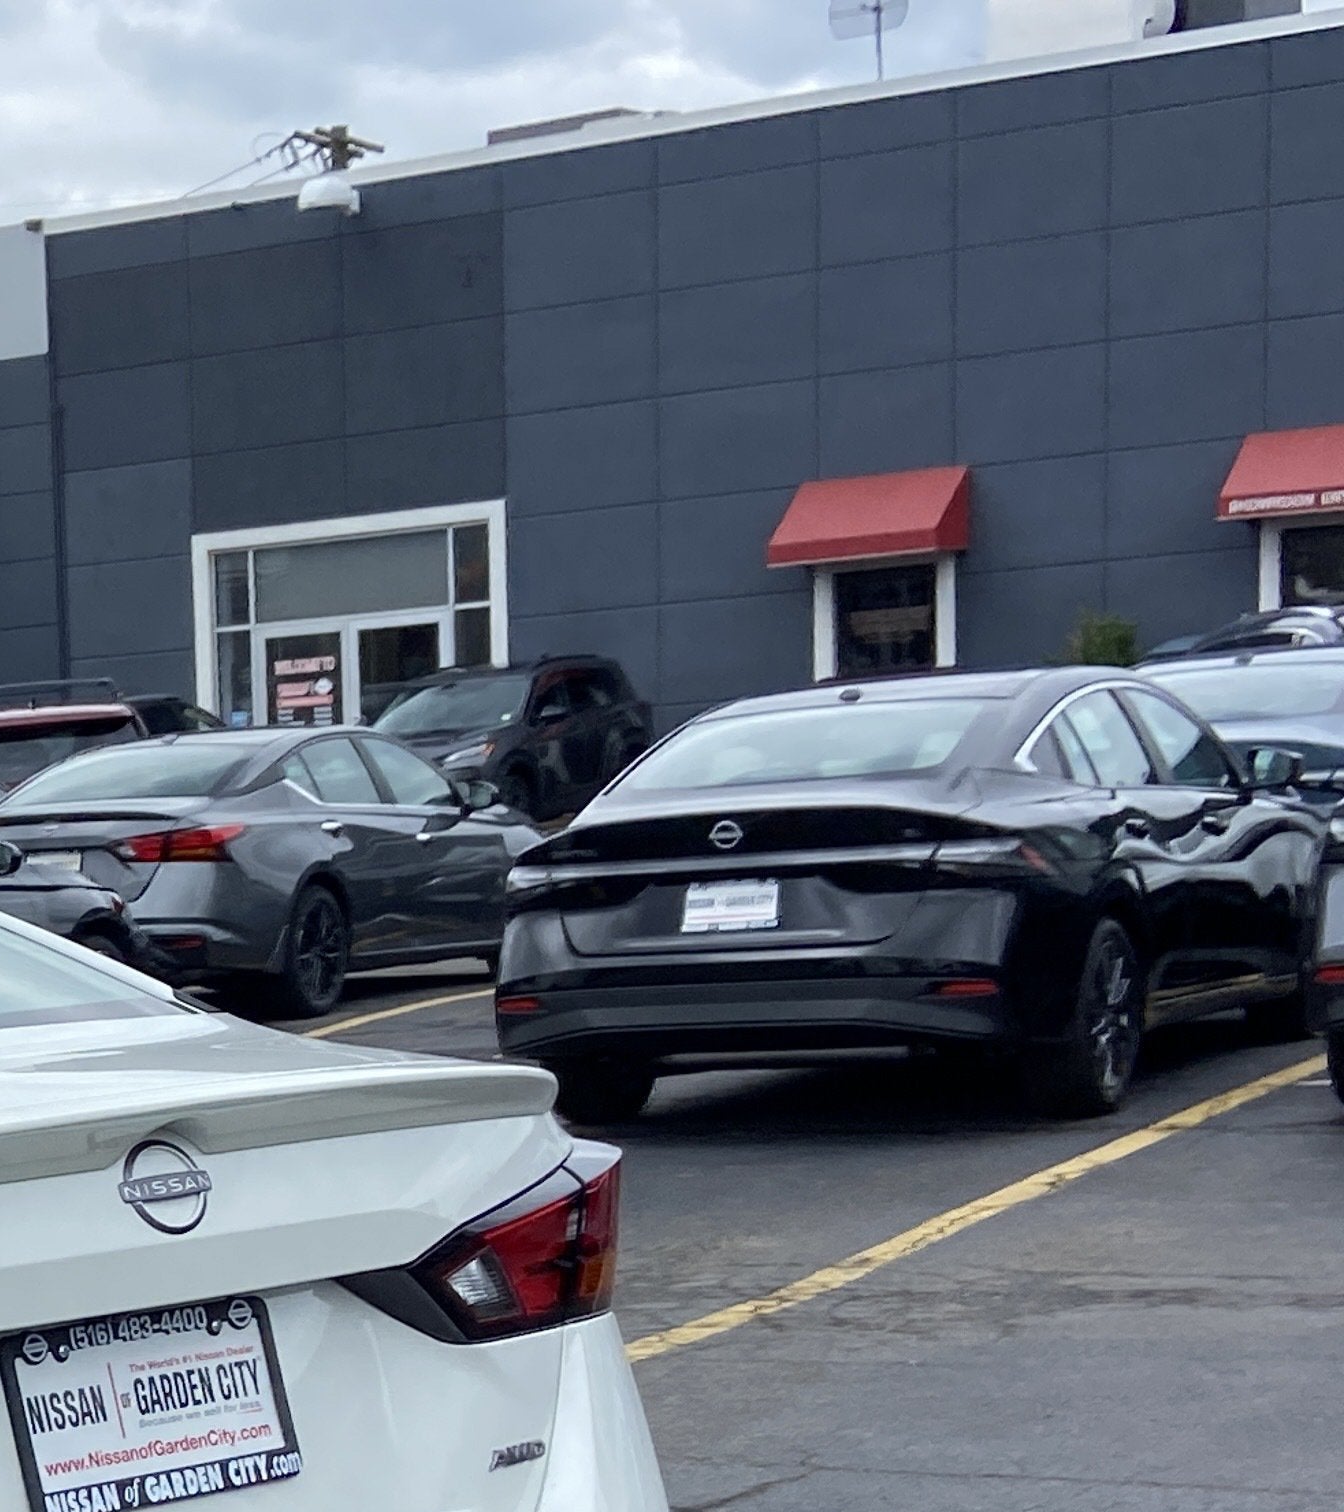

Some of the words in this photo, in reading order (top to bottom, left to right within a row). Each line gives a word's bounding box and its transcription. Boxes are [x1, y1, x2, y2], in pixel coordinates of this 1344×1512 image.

[123, 1174, 209, 1199] NISSAN
[69, 1322, 114, 1350] (516)
[118, 1306, 208, 1341] 483-4400
[26, 1385, 108, 1435] NISSAN
[133, 1366, 216, 1415] GARDEN
[215, 1358, 260, 1401] CITY
[44, 1423, 272, 1477] www.NissanofGardenCity.com
[124, 1477, 141, 1508] of
[144, 1463, 225, 1503] GARDEN
